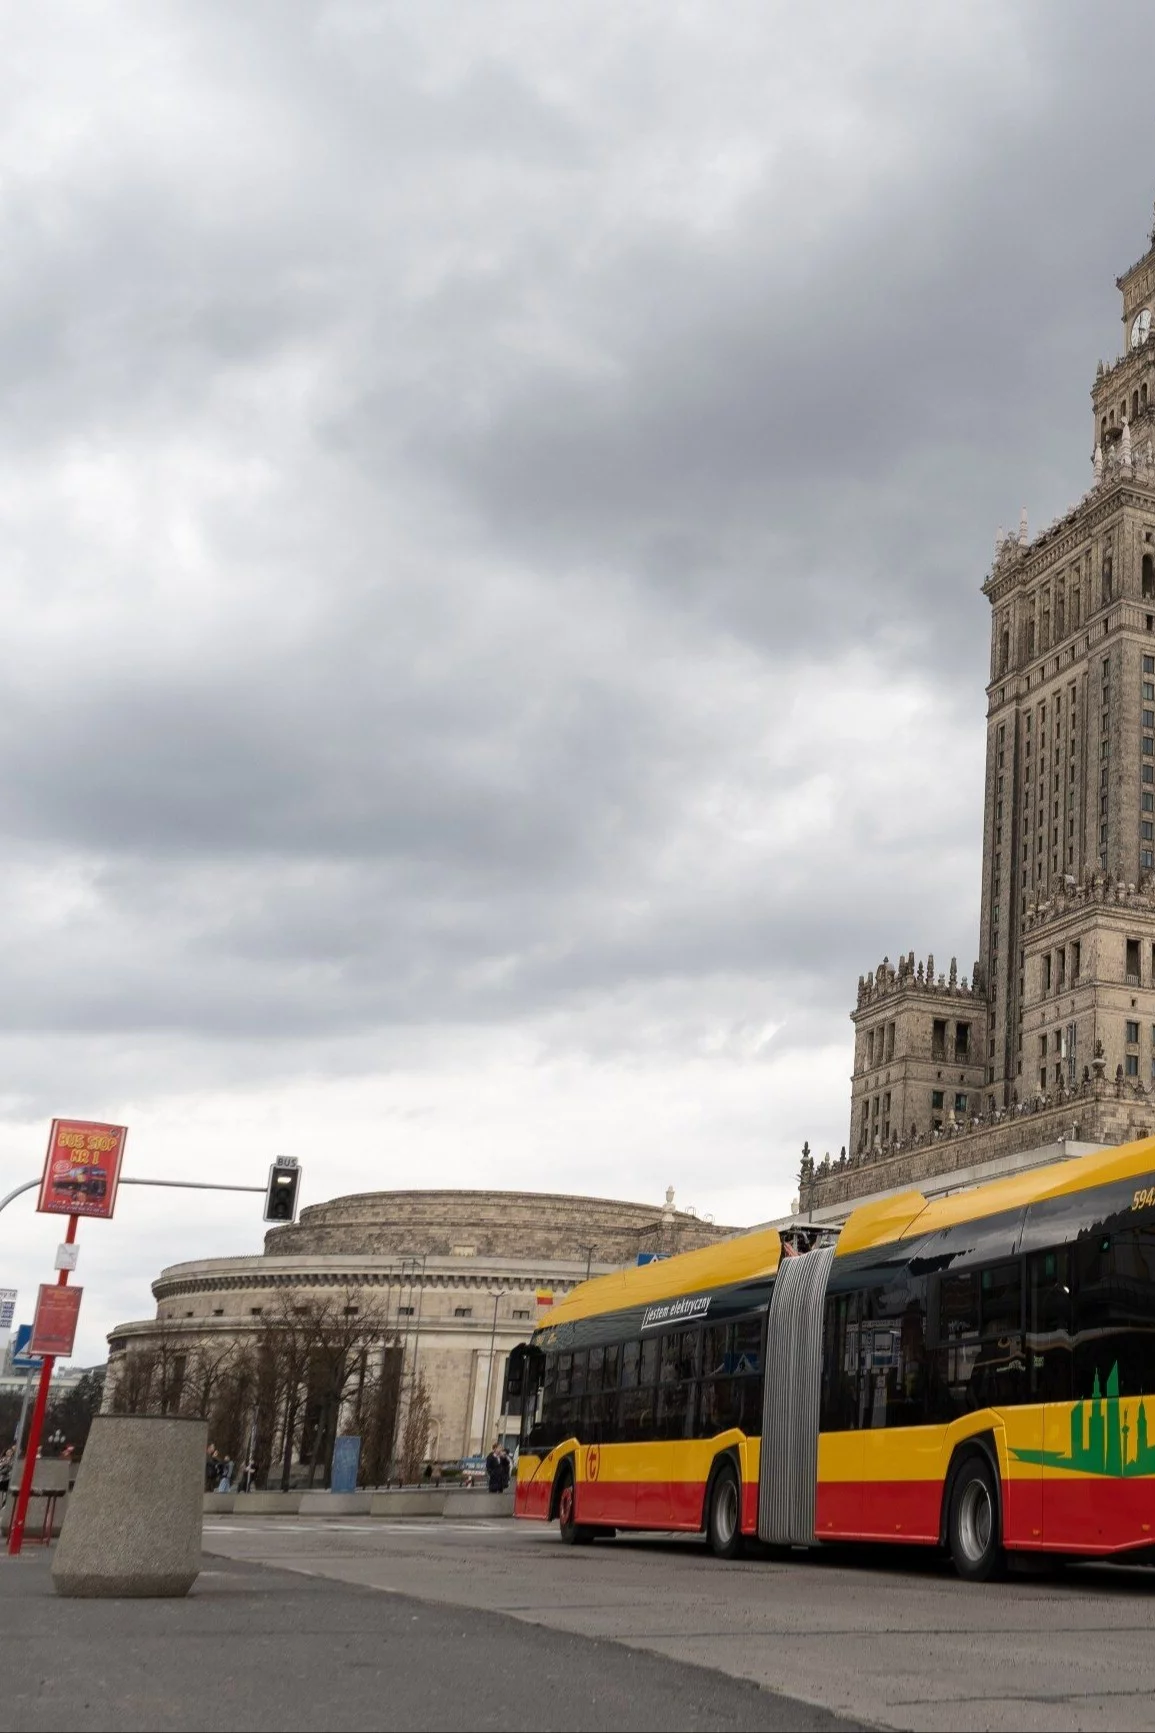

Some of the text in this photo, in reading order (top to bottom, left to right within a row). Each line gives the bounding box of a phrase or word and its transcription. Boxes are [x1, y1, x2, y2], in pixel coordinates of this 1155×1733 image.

[58, 1132, 117, 1151] BUS STOP
[277, 1157, 297, 1168] BUS
[669, 1296, 712, 1316] elektryczny
